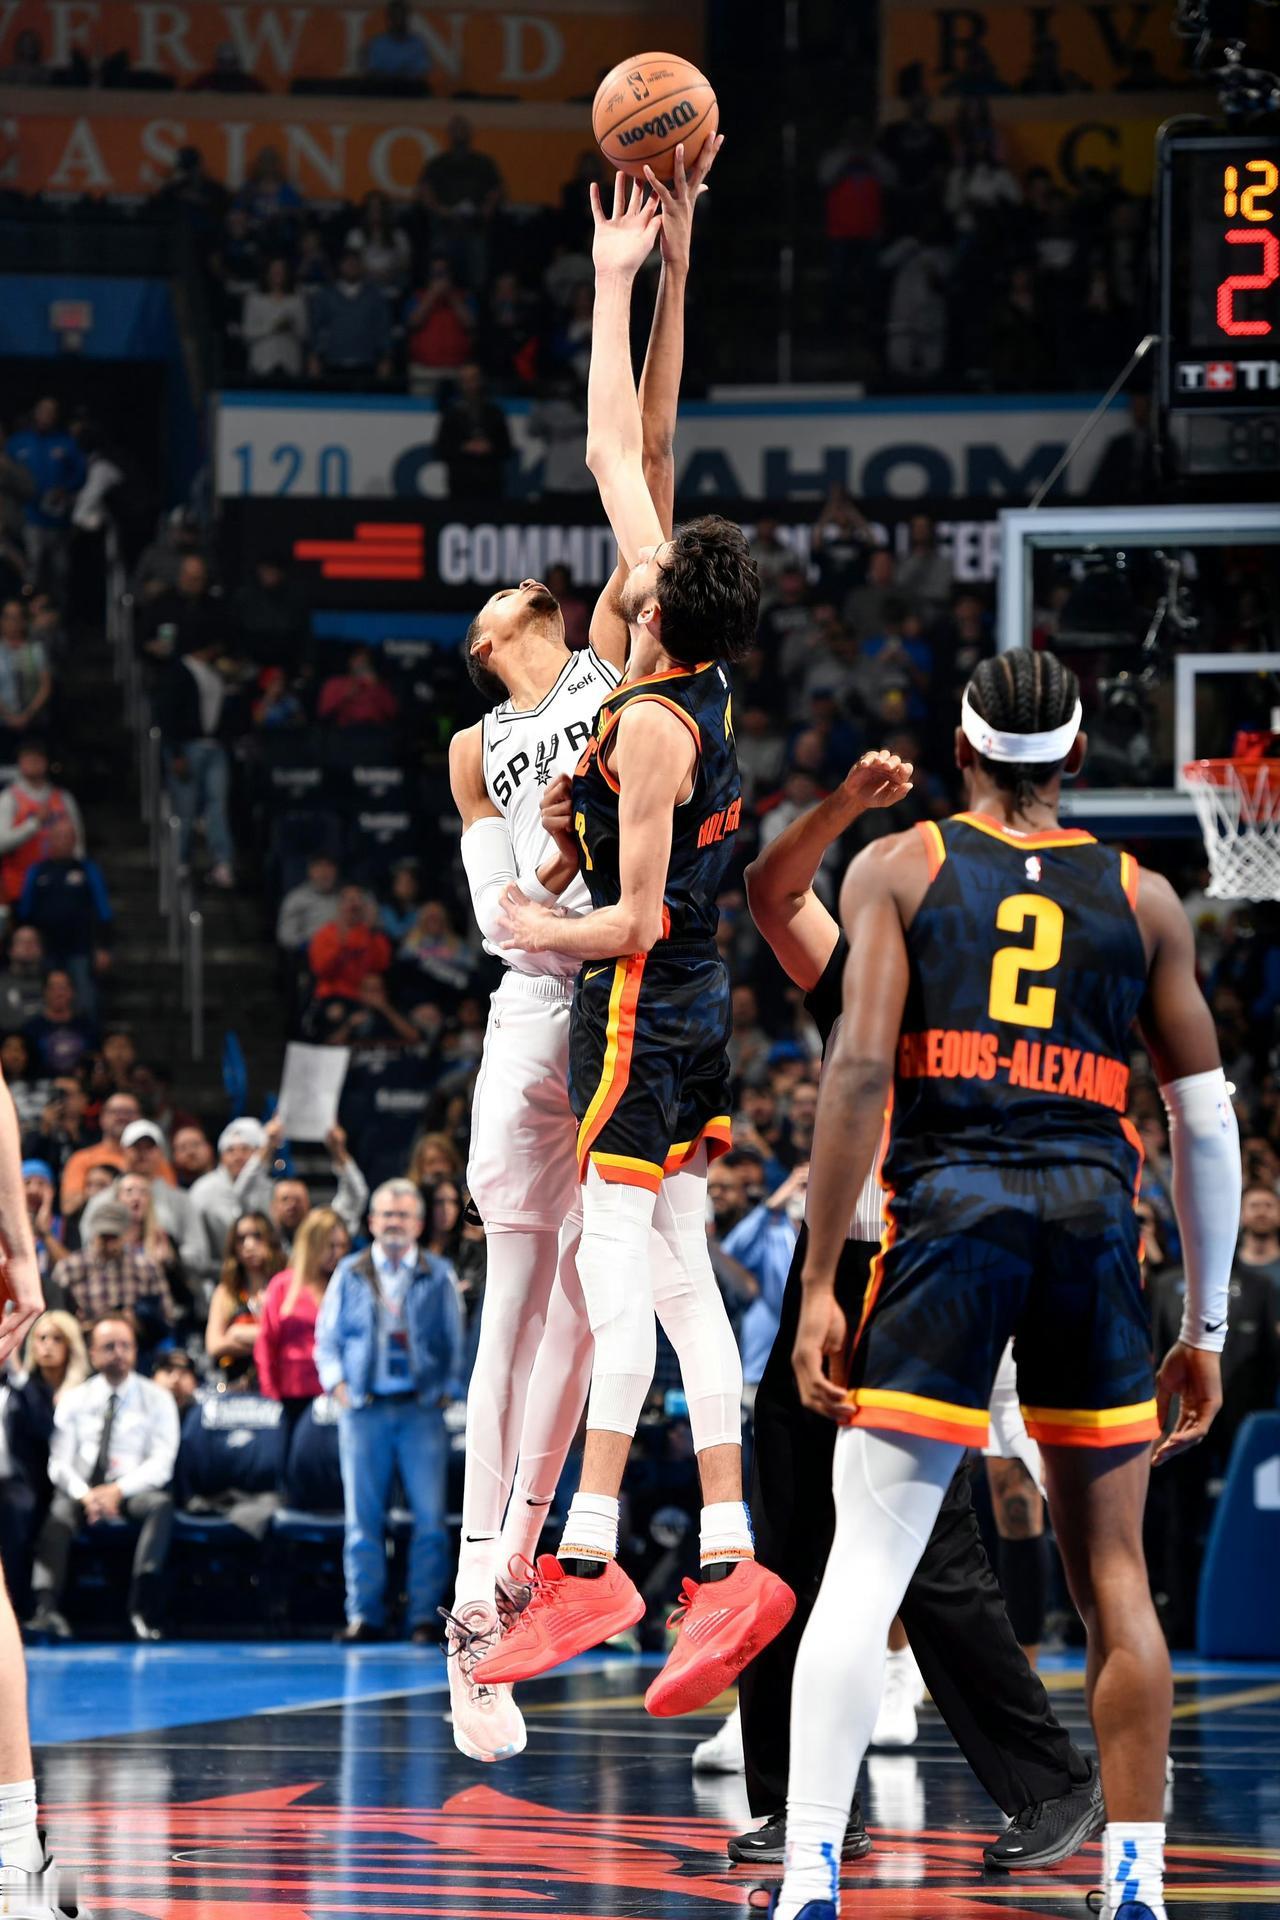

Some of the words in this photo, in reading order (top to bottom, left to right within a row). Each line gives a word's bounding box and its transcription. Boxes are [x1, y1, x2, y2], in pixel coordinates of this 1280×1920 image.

[616, 100, 699, 147] Wilson
[1223, 159, 1279, 222] 12
[232, 439, 352, 498] 120
[567, 671, 597, 695] Self.
[492, 715, 598, 808] SPUR
[988, 892, 1065, 1030] 2
